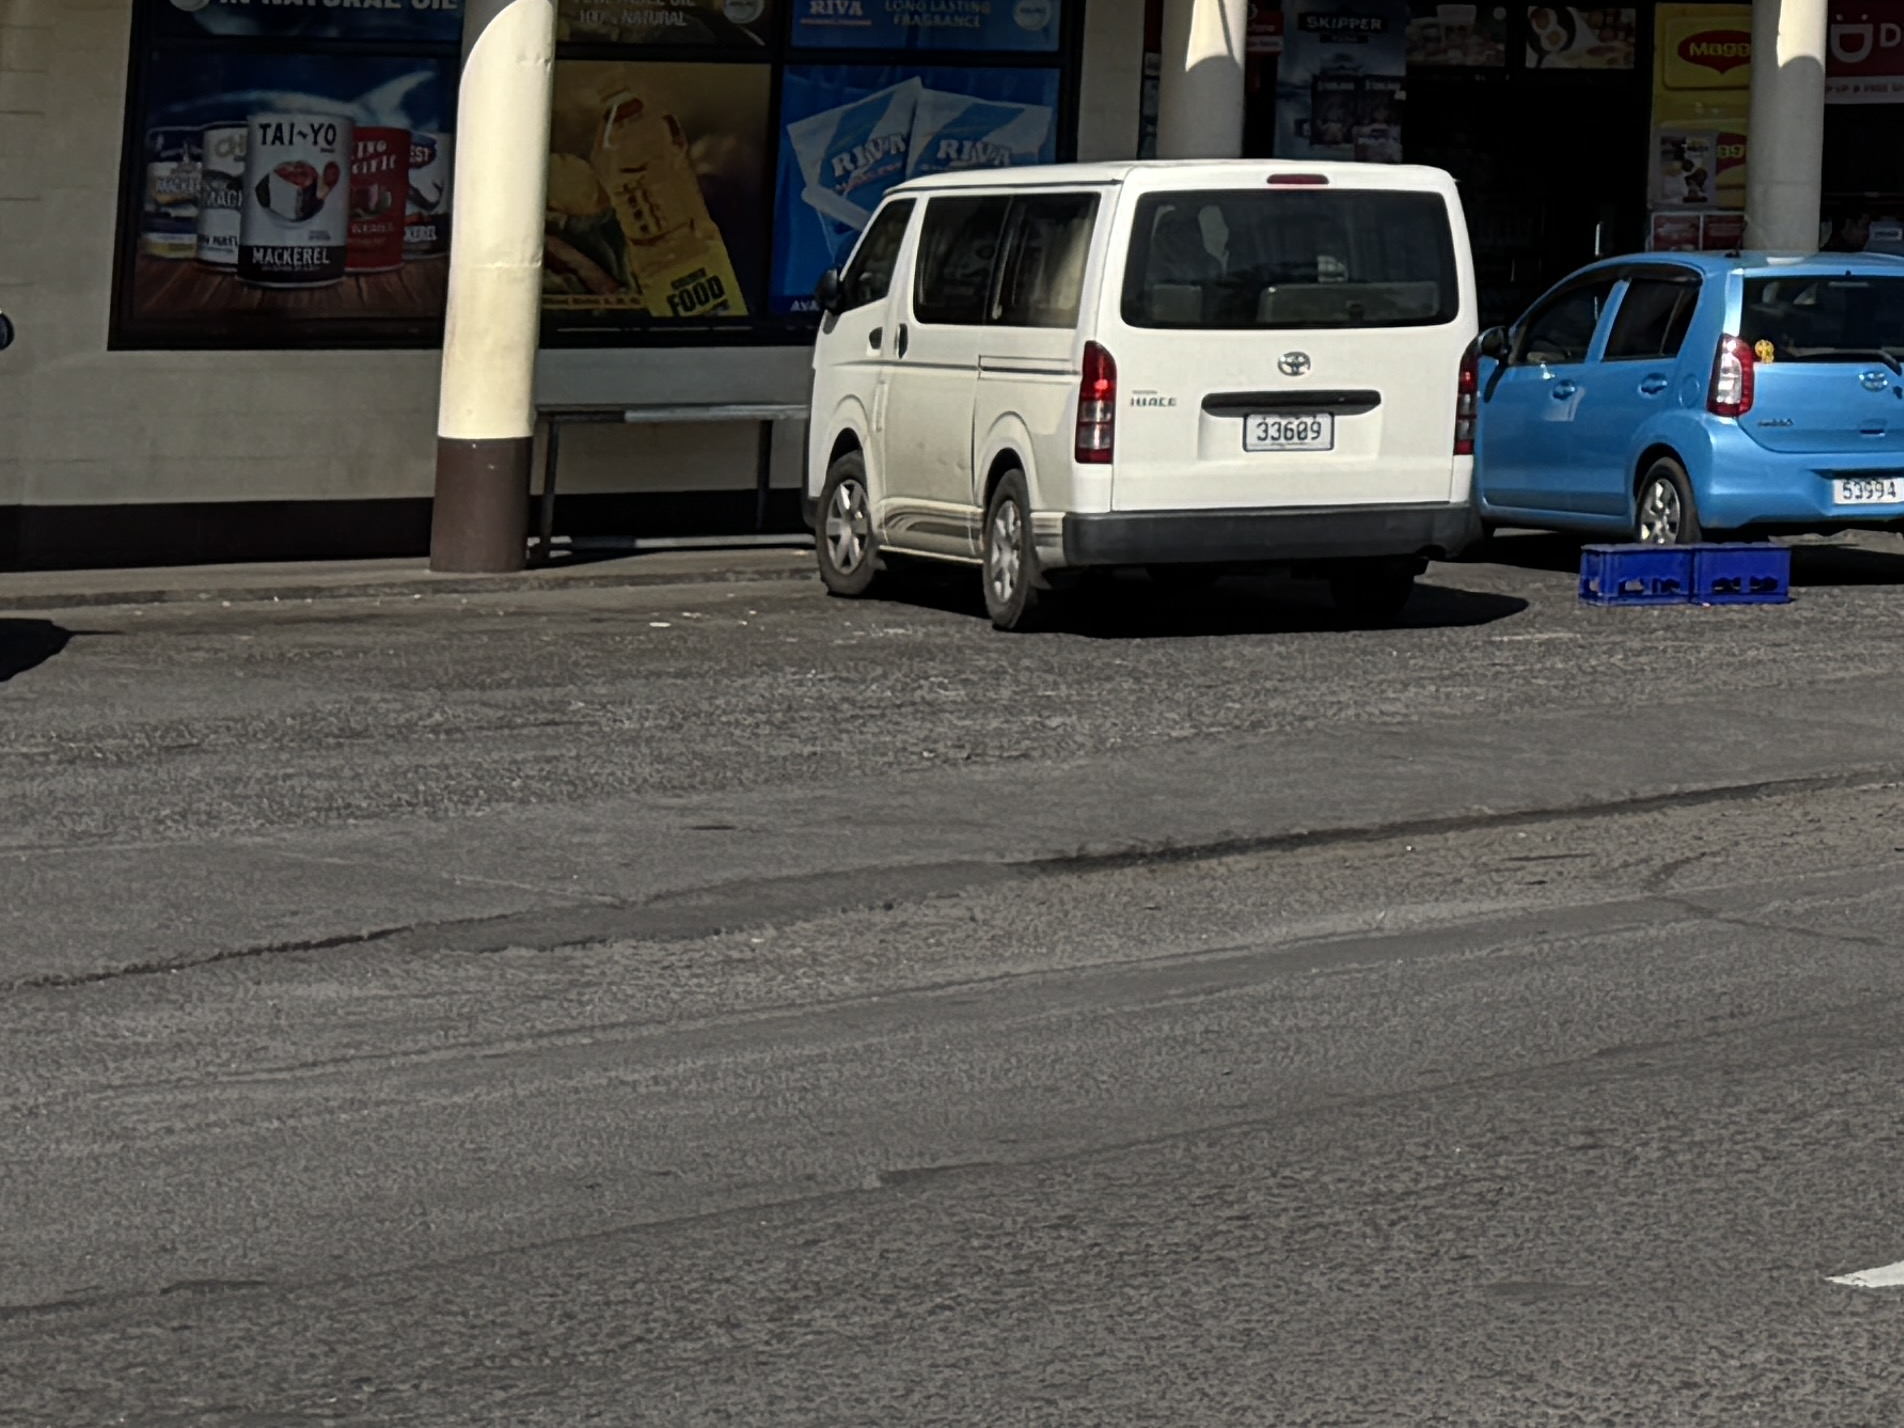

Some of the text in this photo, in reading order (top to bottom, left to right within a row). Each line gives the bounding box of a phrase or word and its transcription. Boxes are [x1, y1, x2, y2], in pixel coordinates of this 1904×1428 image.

[809, 0, 864, 17] RIVA
[929, 0, 992, 16] LASTING
[621, 9, 688, 28] NATURAL
[1305, 15, 1383, 31] SKIPPER
[1689, 41, 1751, 58] Magg
[831, 133, 909, 178] RIVA
[936, 138, 1013, 165] RIVA
[252, 246, 331, 265] MACKEREL
[666, 274, 726, 318] FOOD
